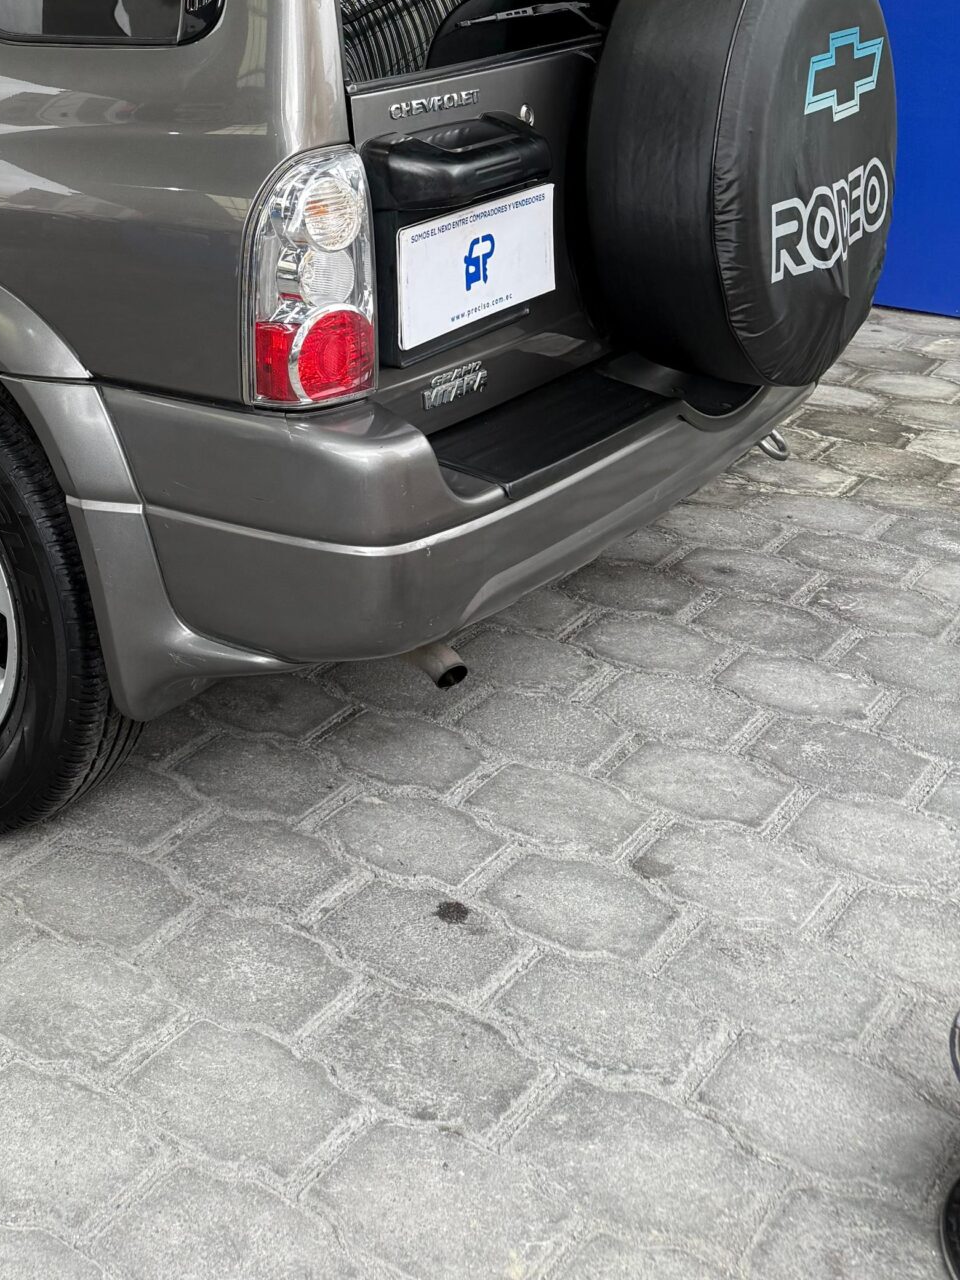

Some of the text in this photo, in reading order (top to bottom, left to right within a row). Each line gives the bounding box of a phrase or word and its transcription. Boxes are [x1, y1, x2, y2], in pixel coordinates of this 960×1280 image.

[388, 88, 480, 120] CHEVROLET
[410, 230, 430, 244] SOMOS
[430, 228, 438, 237] EL
[437, 222, 451, 234] NEXO
[452, 217, 469, 229] ENTRE
[469, 204, 508, 223] COMPRADORES
[511, 193, 545, 209] VENDEDORES
[771, 157, 888, 284] RODEO
[451, 293, 512, 322] www.preciso.com.ec
